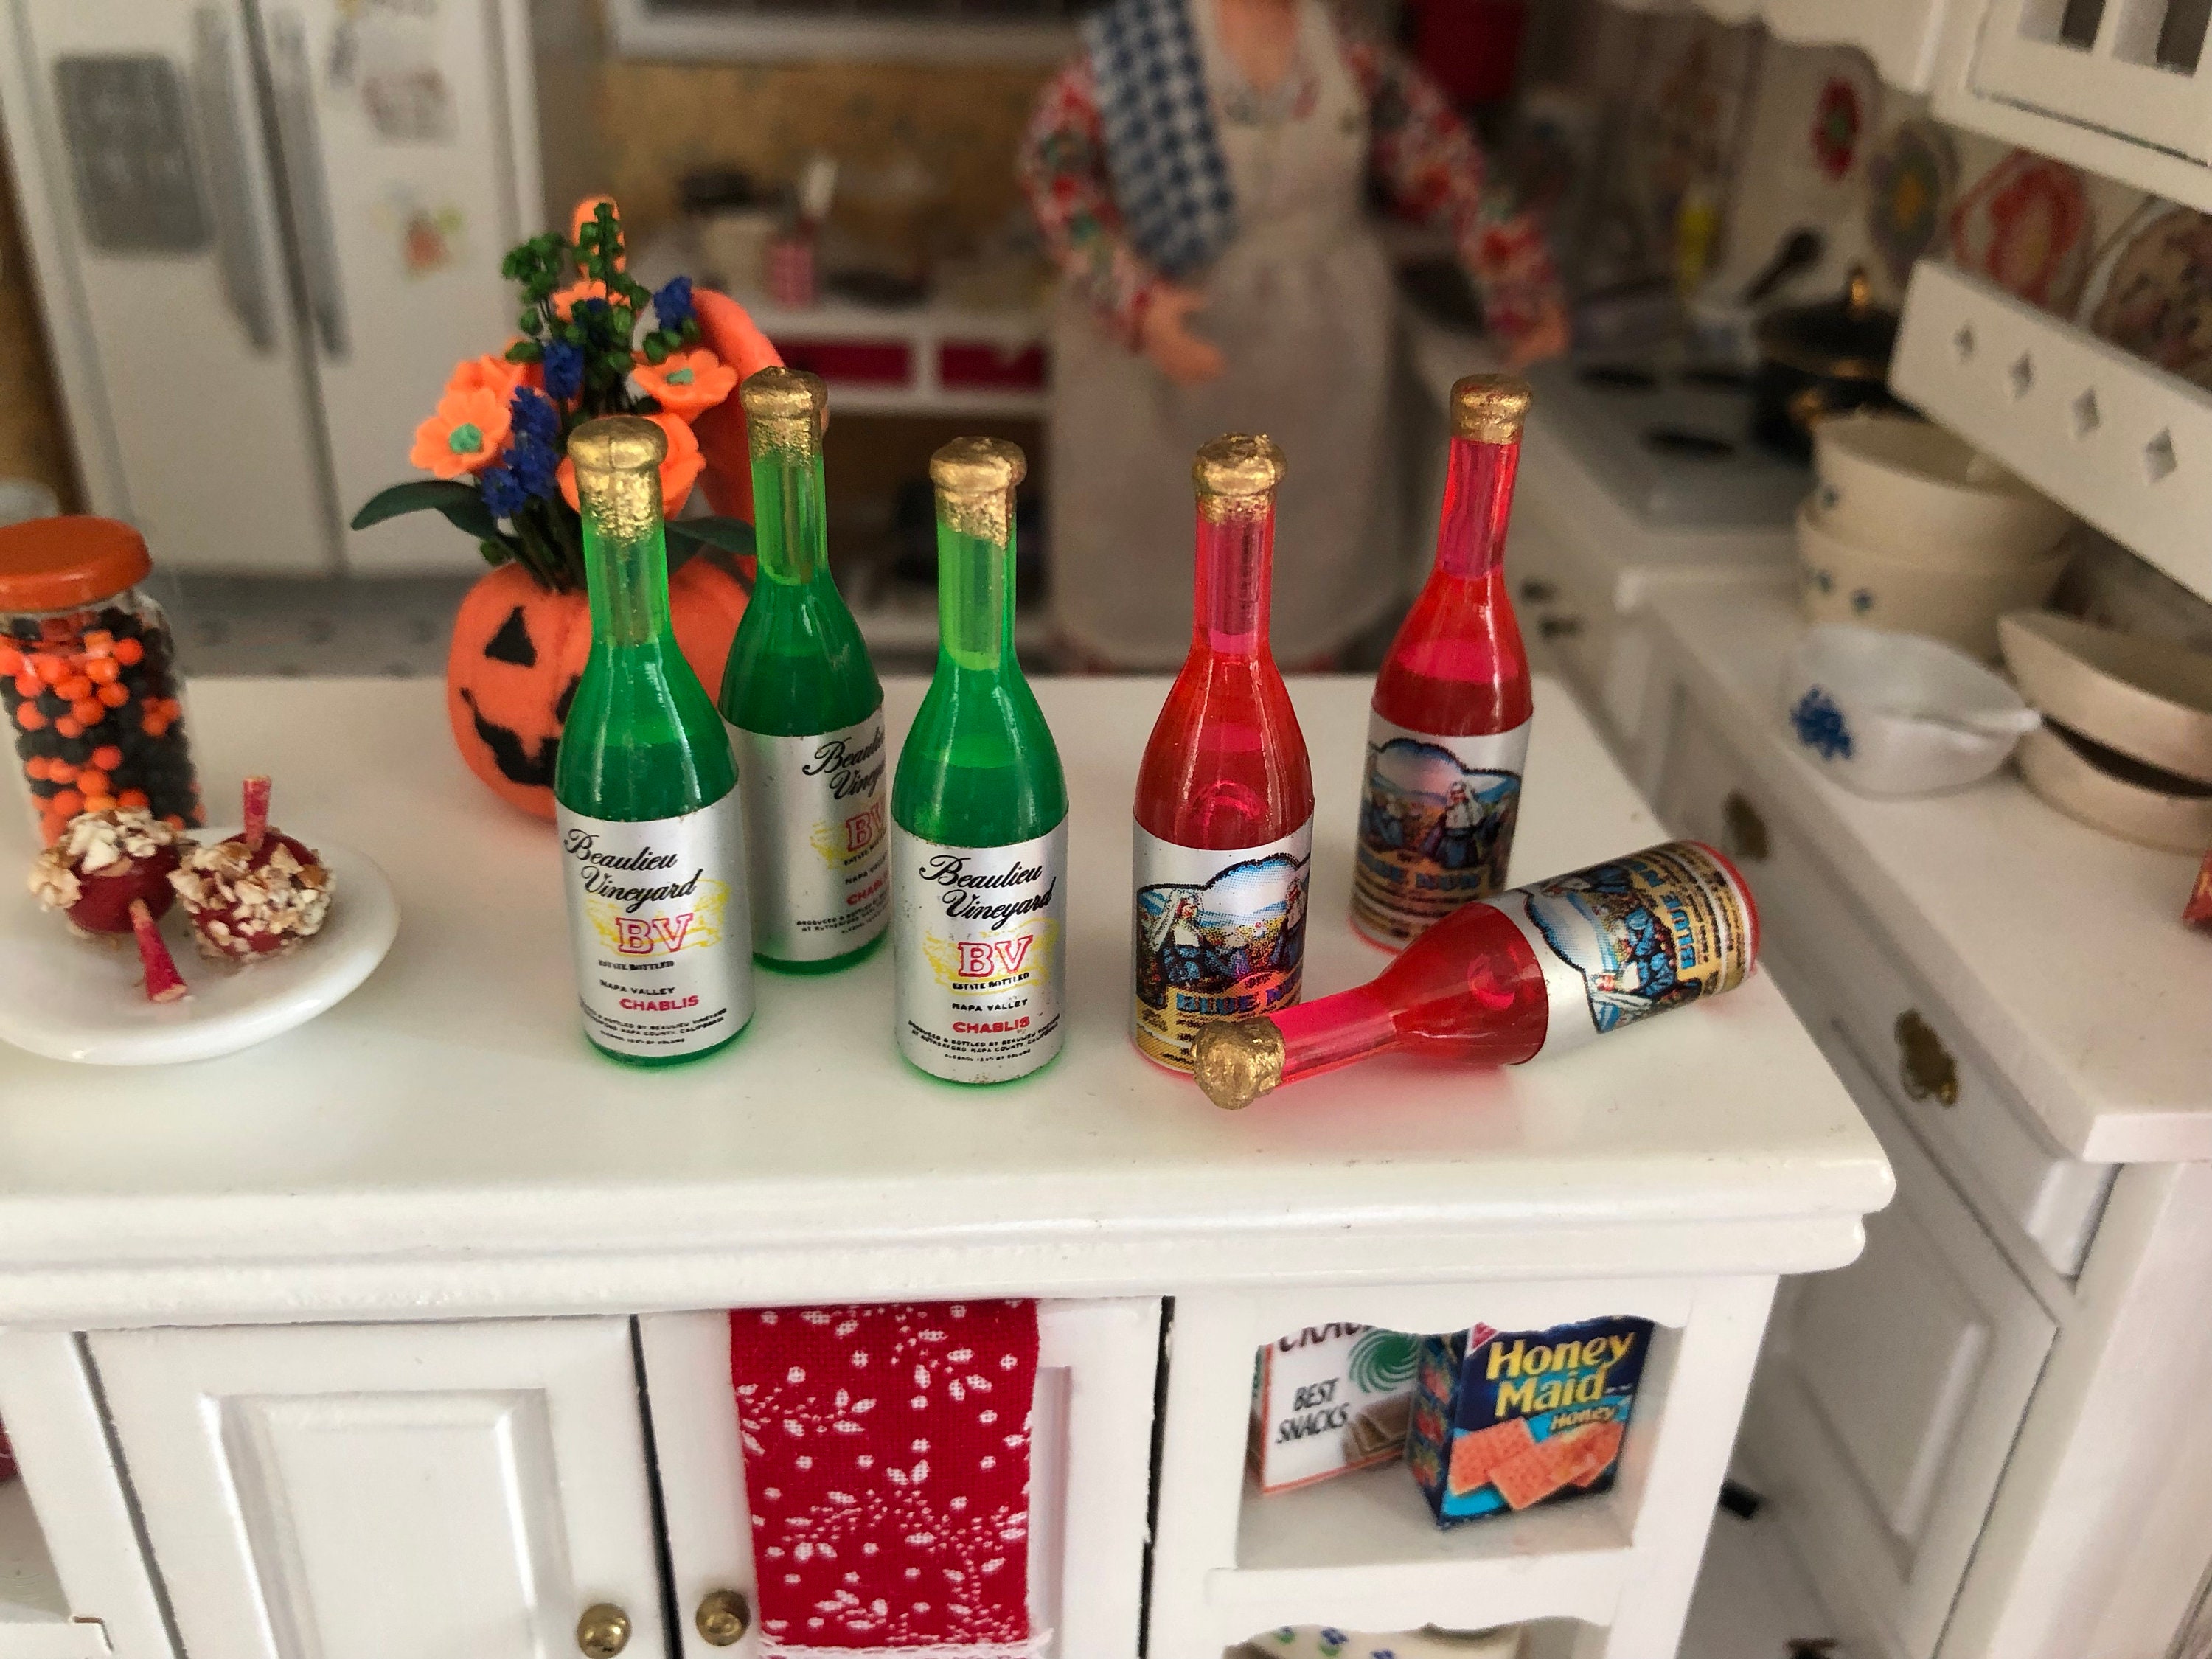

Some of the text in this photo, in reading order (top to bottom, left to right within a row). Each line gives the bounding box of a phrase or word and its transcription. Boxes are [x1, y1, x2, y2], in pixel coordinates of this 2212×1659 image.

[563, 829, 679, 871] Beaulieu
[581, 866, 703, 914] Vineyard
[919, 855, 1043, 889] Beaulieu
[942, 876, 1057, 931] Vineyard
[615, 912, 694, 954] BV
[1661, 891, 1697, 970] BLUE
[958, 934, 1034, 978] BV
[599, 979, 676, 995] NAPA VALLEY
[952, 972, 1030, 990] ESTATE BOTTLED
[619, 995, 700, 1012] CHABLIS
[952, 998, 1028, 1012] NAPA VALLEY
[951, 1039, 986, 1047] BOTTLED
[952, 1015, 1031, 1034] CHABLIS
[1486, 1332, 1637, 1381] Honey
[1294, 1377, 1340, 1411] BEST
[1494, 1366, 1609, 1419] Maid
